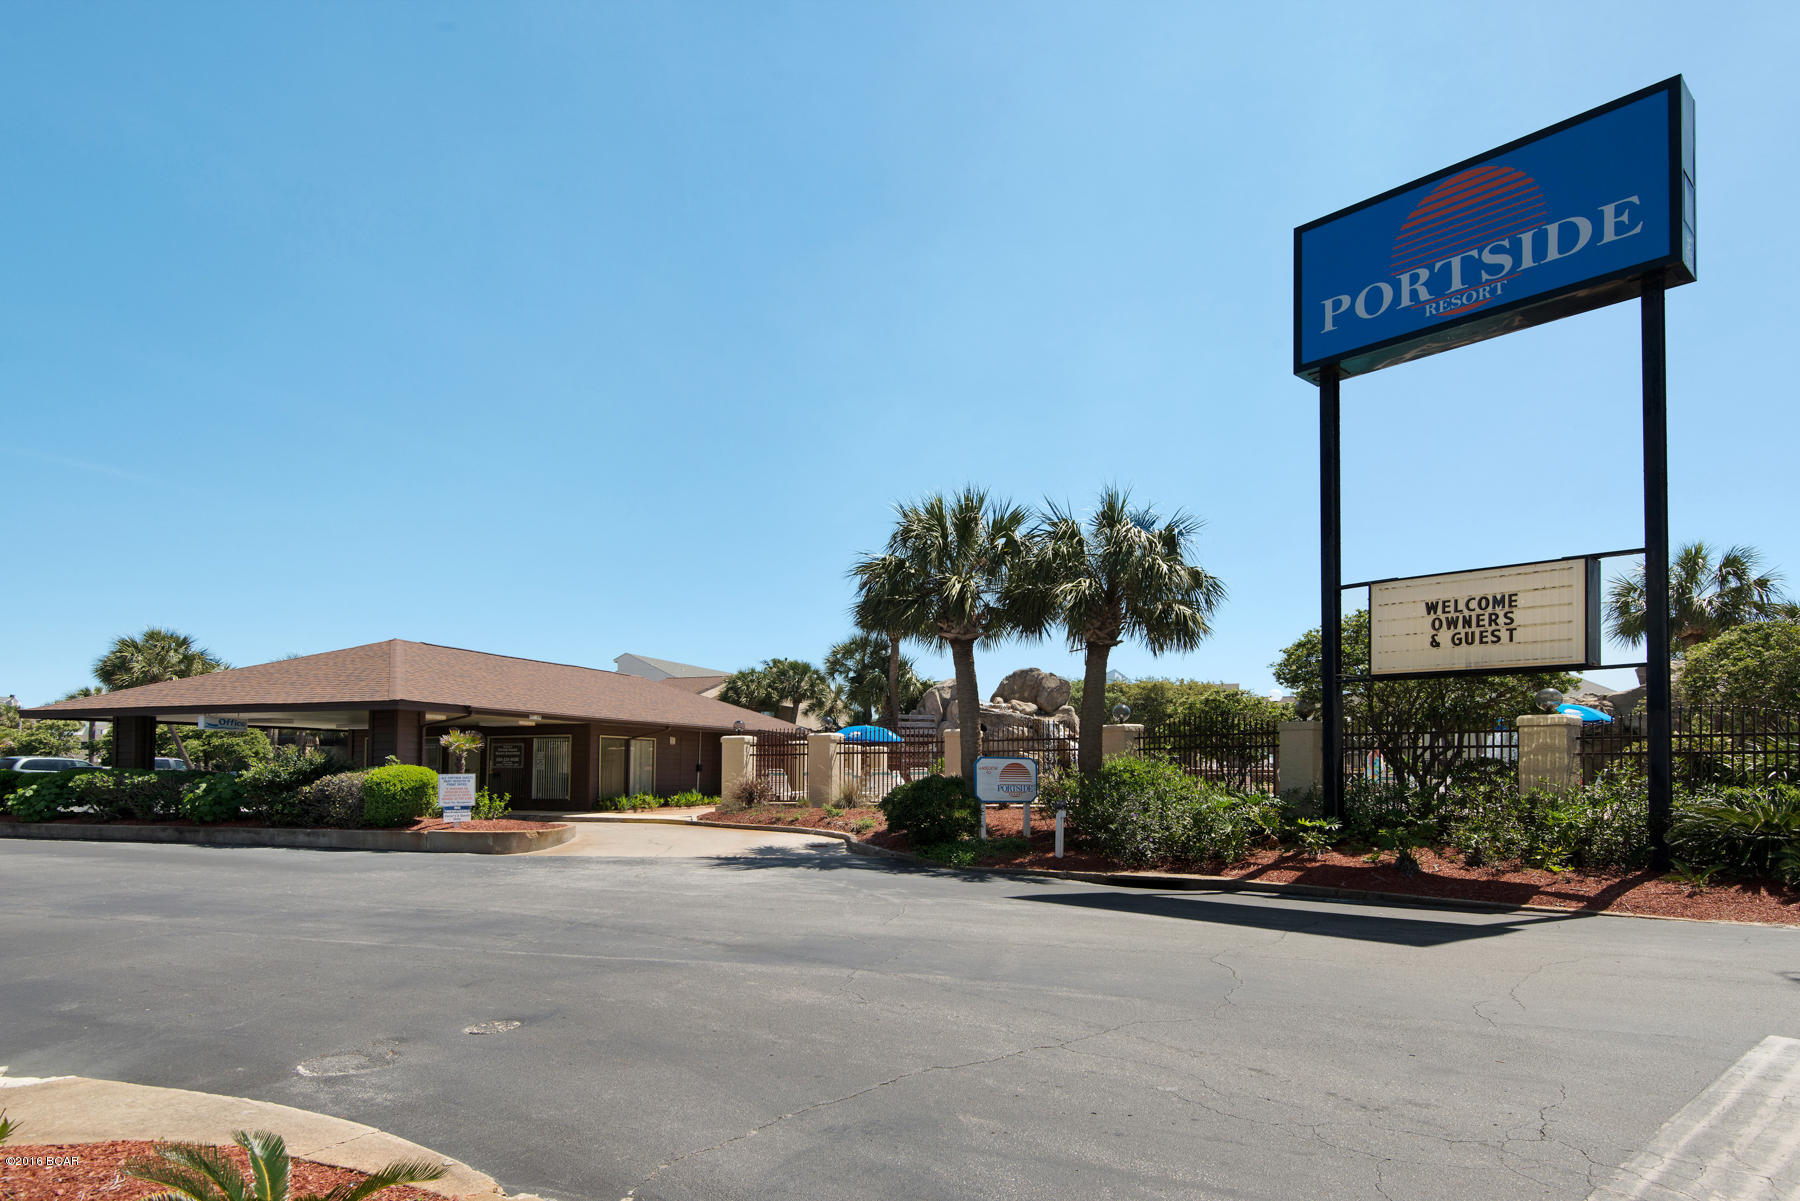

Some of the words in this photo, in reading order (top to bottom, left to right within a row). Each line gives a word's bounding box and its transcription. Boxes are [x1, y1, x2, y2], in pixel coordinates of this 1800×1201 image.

[1320, 195, 1644, 334] PORTSIDE
[1424, 280, 1508, 318] RESORT
[1424, 593, 1518, 616] WELCOME
[1431, 611, 1515, 631] OWNERS
[1429, 633, 1441, 648] &
[1451, 627, 1517, 647] GUEST
[218, 718, 247, 727] Office
[997, 784, 1034, 792] PORTSIDE
